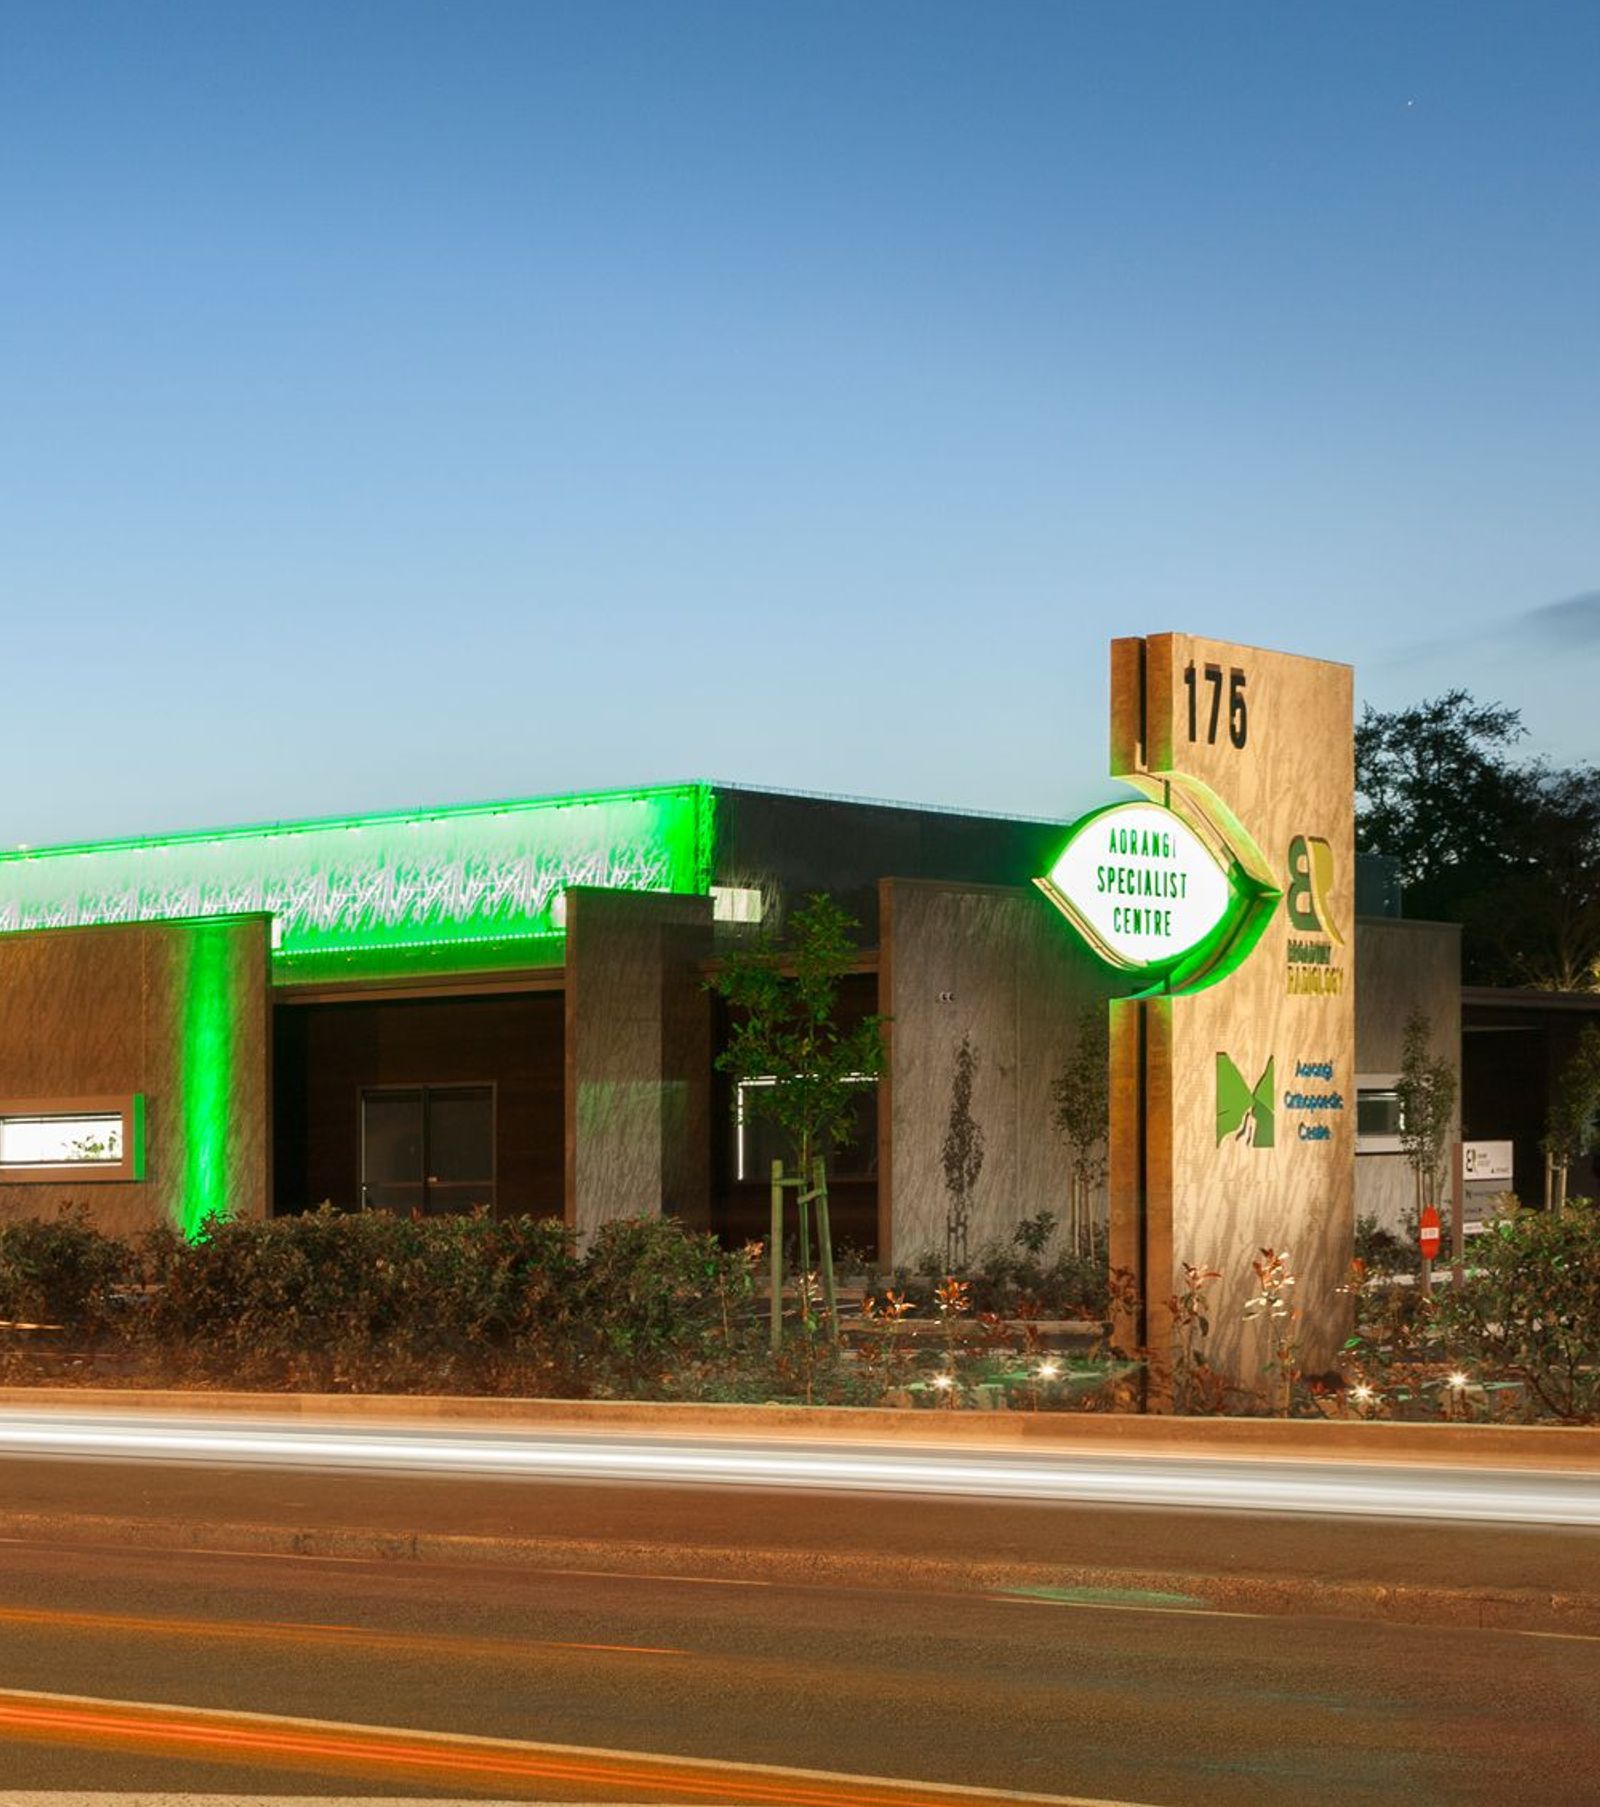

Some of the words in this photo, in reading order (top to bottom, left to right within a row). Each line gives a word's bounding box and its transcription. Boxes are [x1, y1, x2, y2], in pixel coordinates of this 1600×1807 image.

[1184, 659, 1247, 749] 175
[1109, 827, 1176, 858] AORANGI
[1097, 865, 1187, 898] SPECIALIST
[1113, 906, 1172, 936] CENTRE
